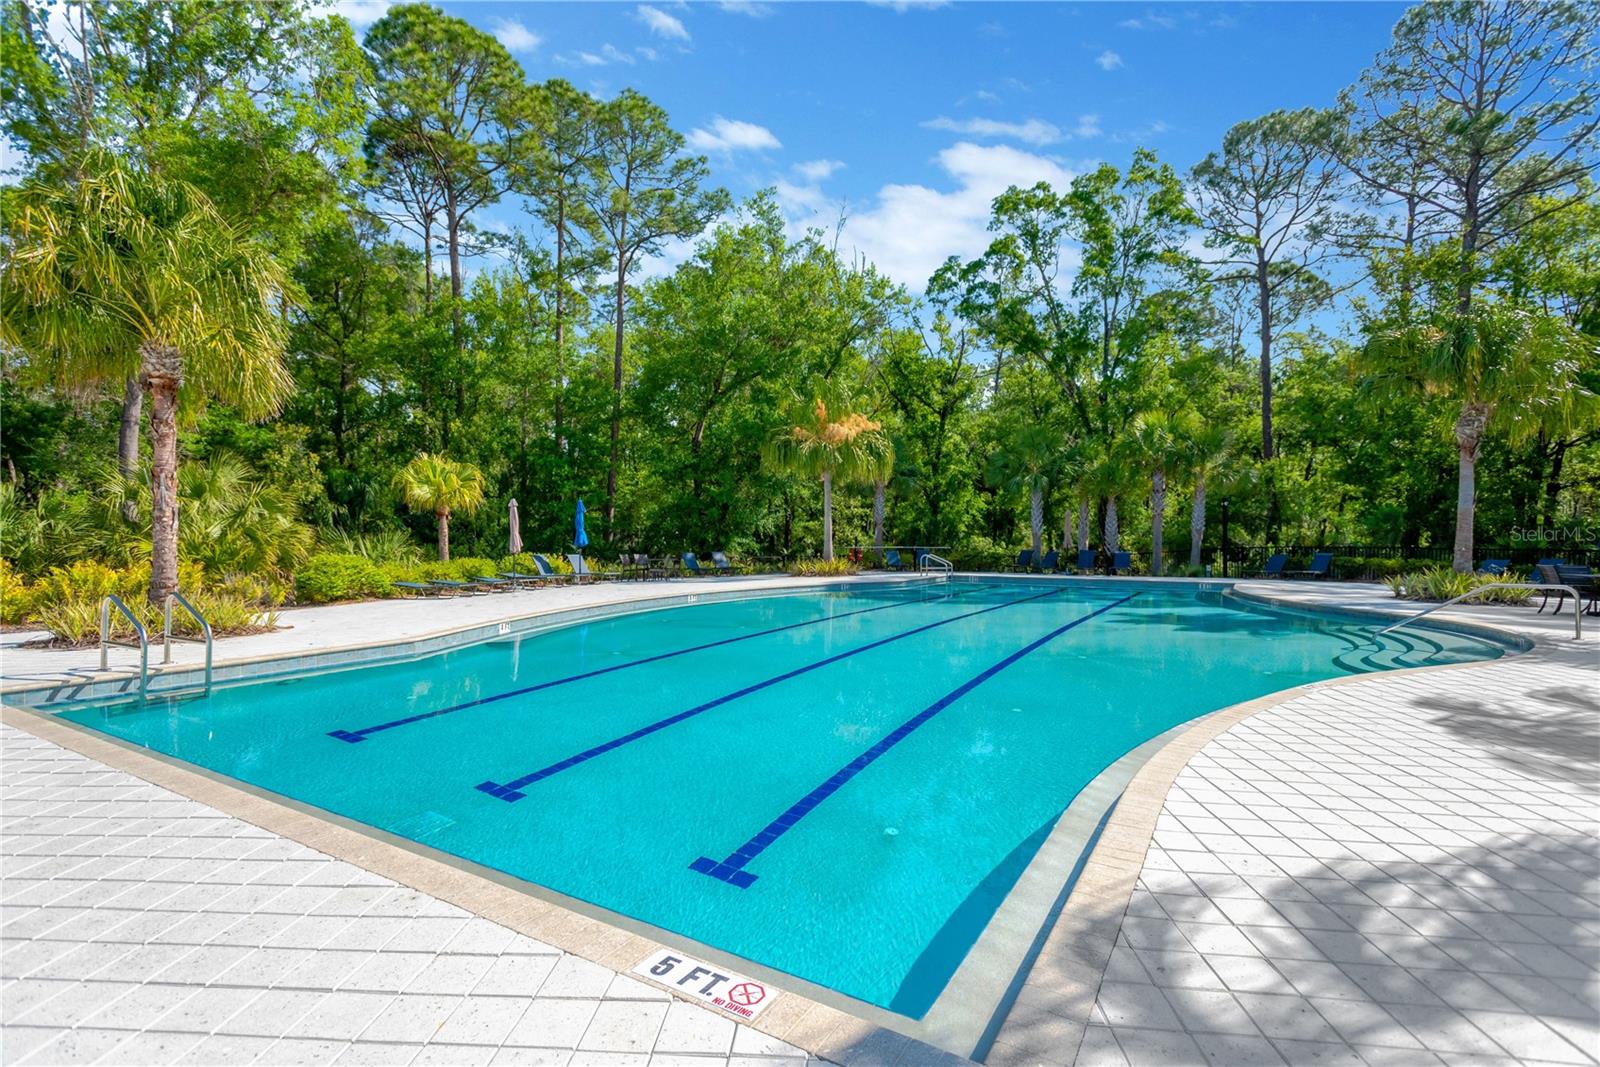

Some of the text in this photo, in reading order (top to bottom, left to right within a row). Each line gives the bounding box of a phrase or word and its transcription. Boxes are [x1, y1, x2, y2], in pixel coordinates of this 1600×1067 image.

[650, 955, 730, 996] 5 FT.
[712, 996, 753, 1017] NO DIVING
